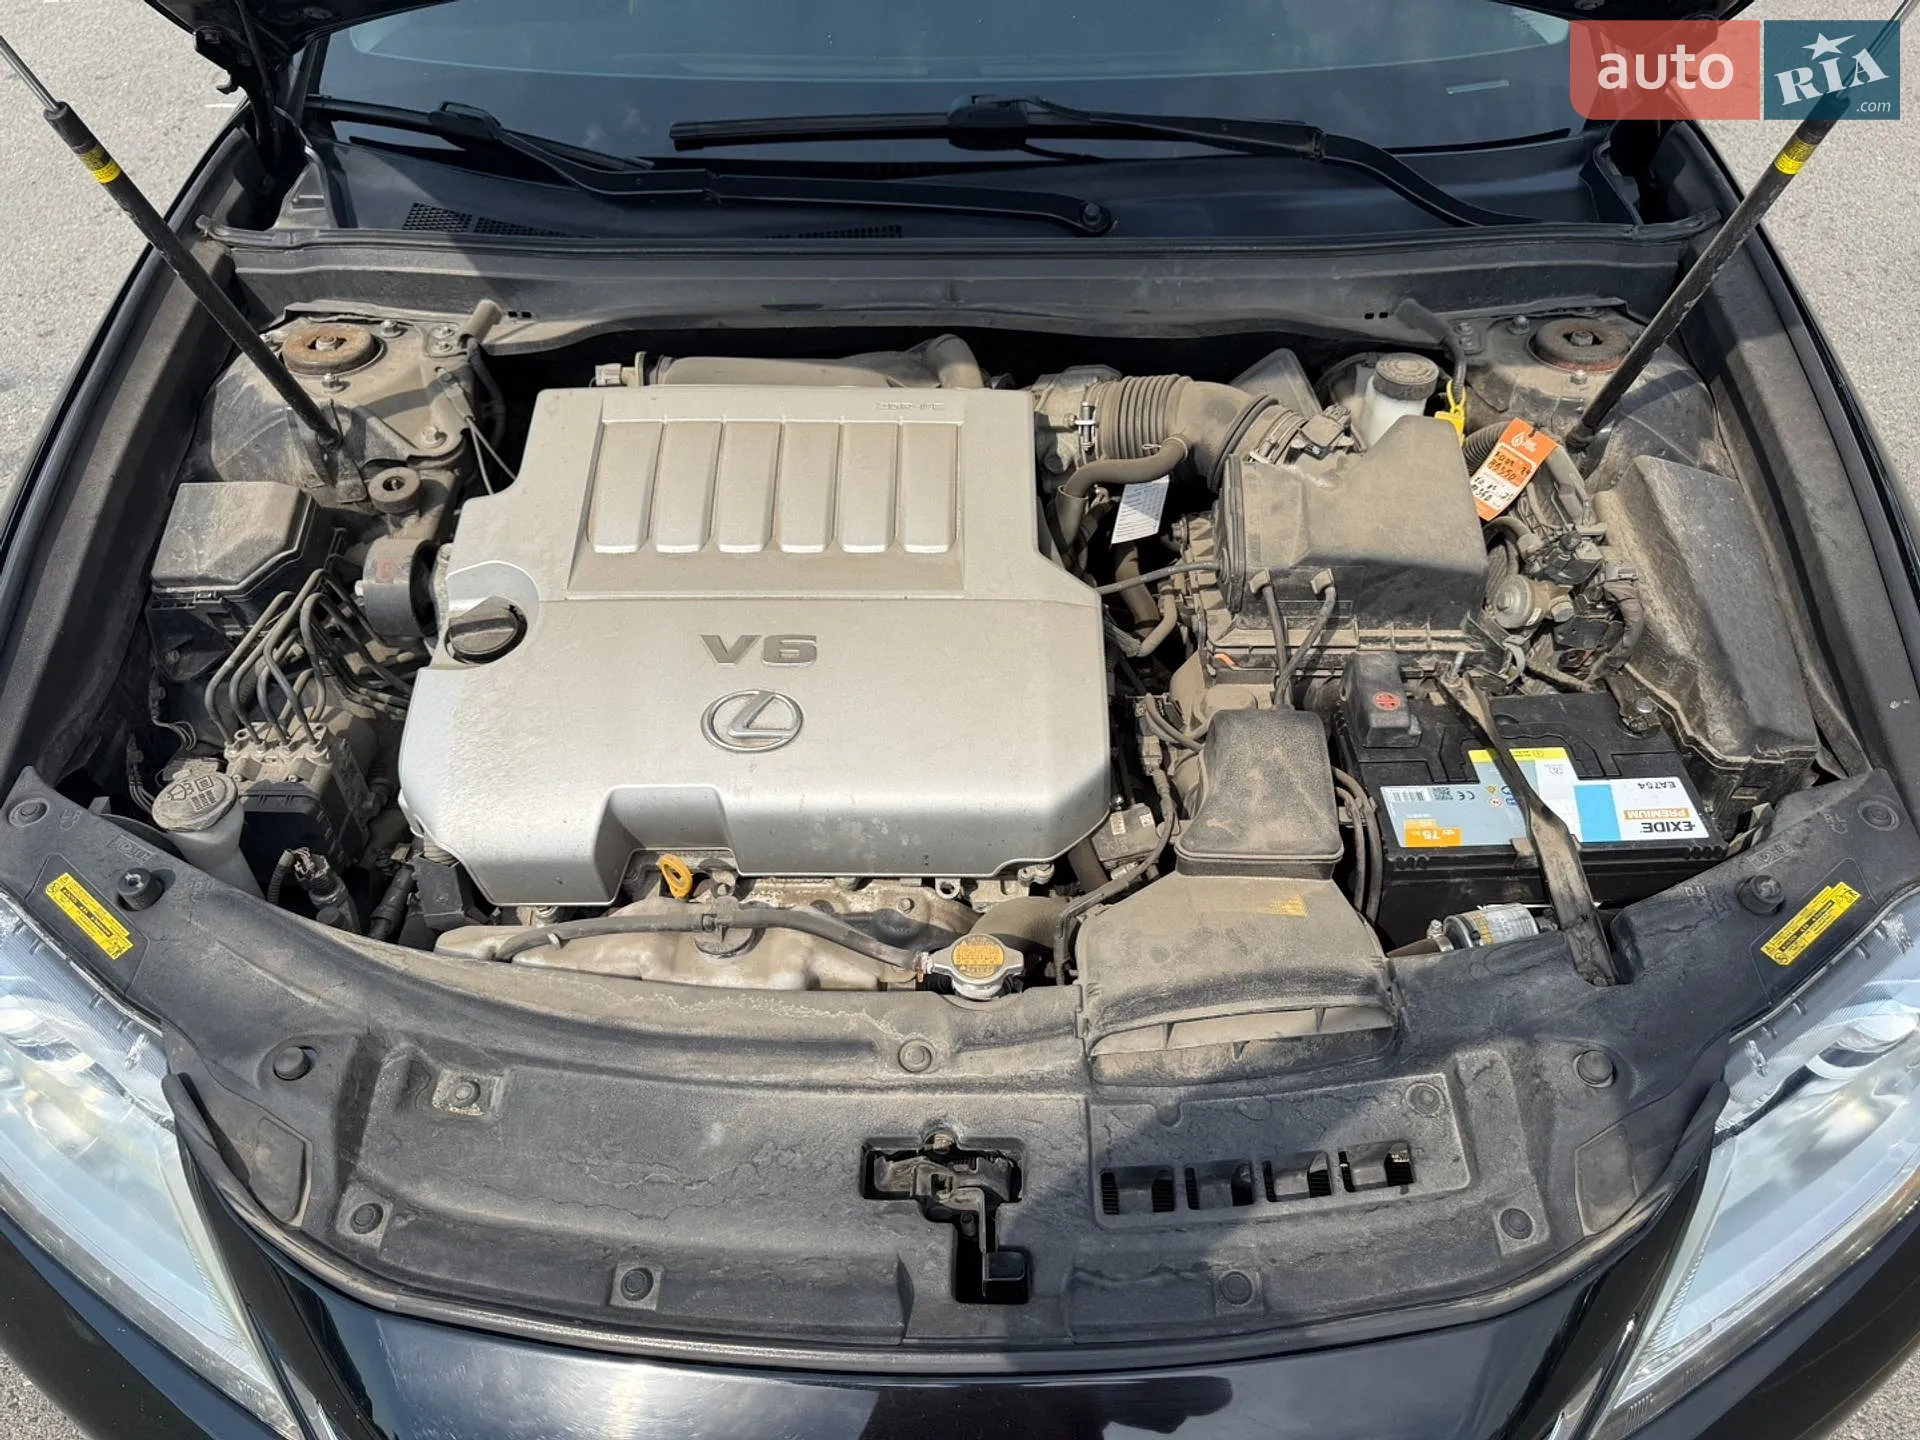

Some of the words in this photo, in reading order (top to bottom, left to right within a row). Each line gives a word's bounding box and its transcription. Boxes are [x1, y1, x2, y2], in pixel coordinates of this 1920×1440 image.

[700, 634, 817, 666] V6
[1627, 808, 1687, 819] PREMIUM
[1641, 821, 1696, 833] EXIDE
